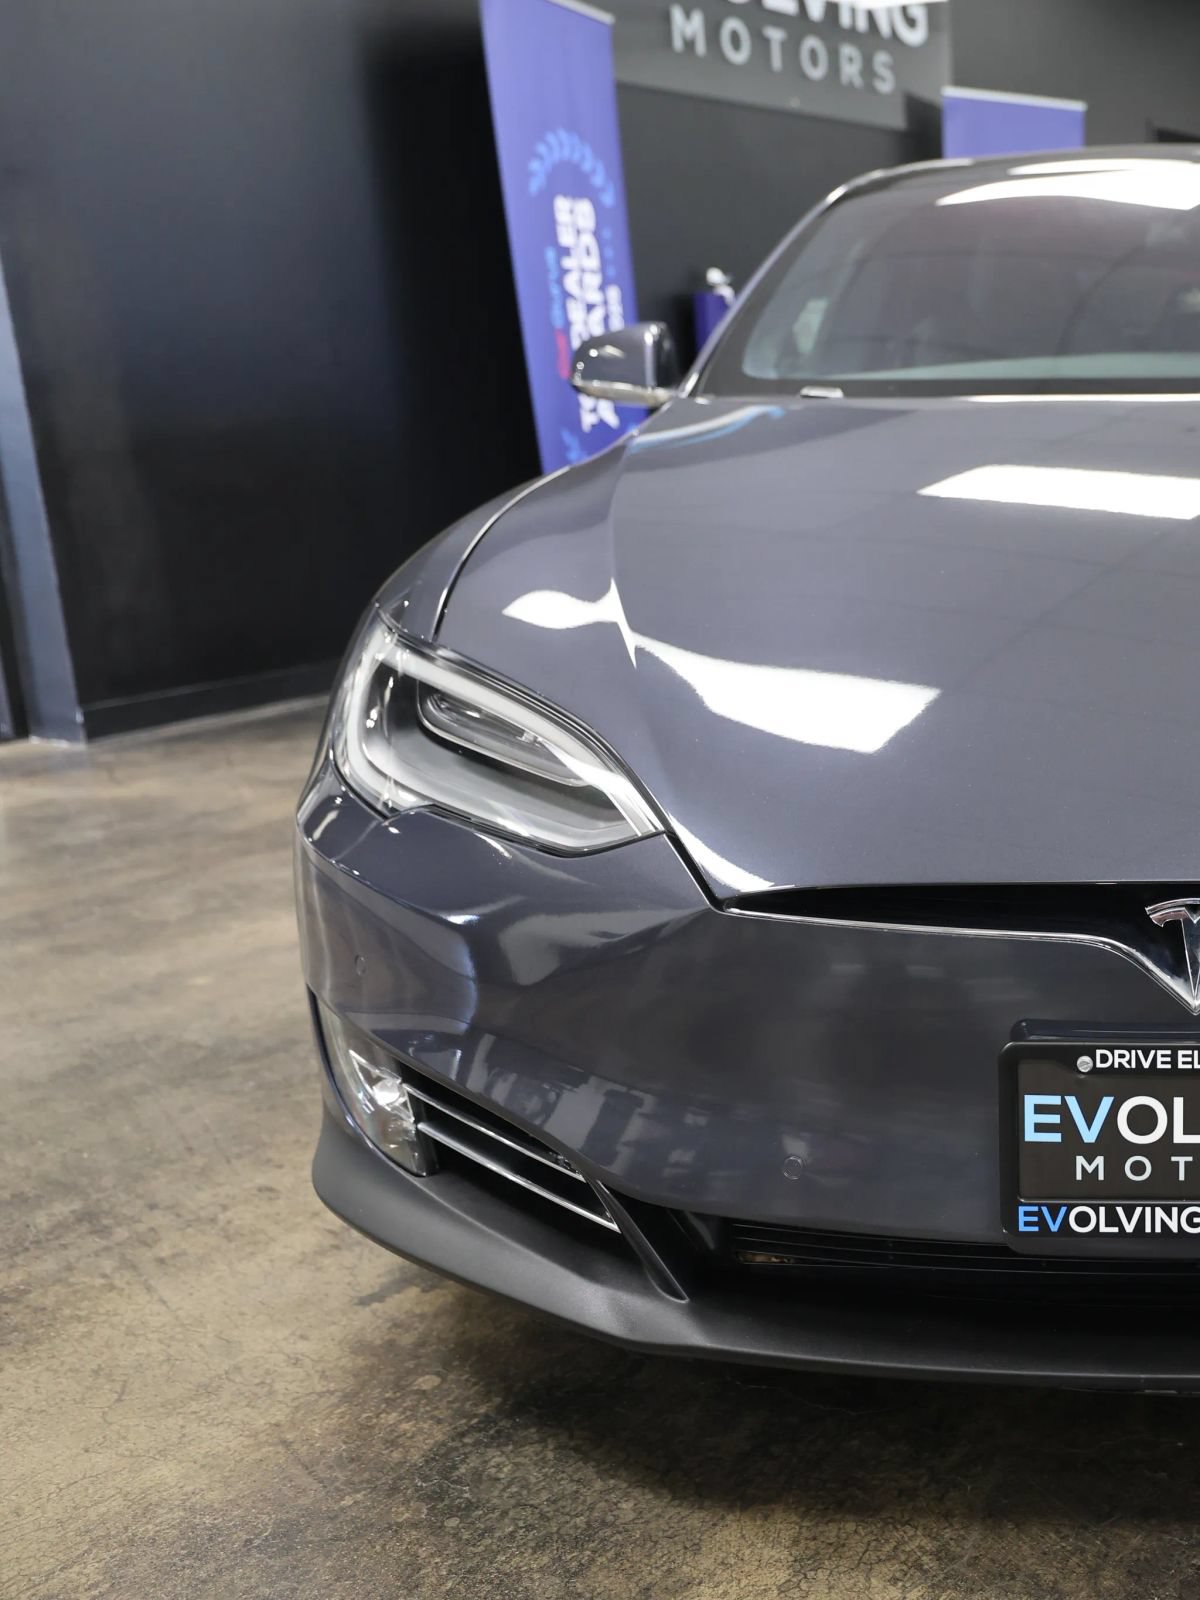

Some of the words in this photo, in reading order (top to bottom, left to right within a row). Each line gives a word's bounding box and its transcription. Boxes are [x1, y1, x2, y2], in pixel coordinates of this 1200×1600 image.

[669, 3, 897, 94] MOTORS
[574, 199, 620, 430] AARDS
[1096, 1049, 1171, 1068] DRIVE
